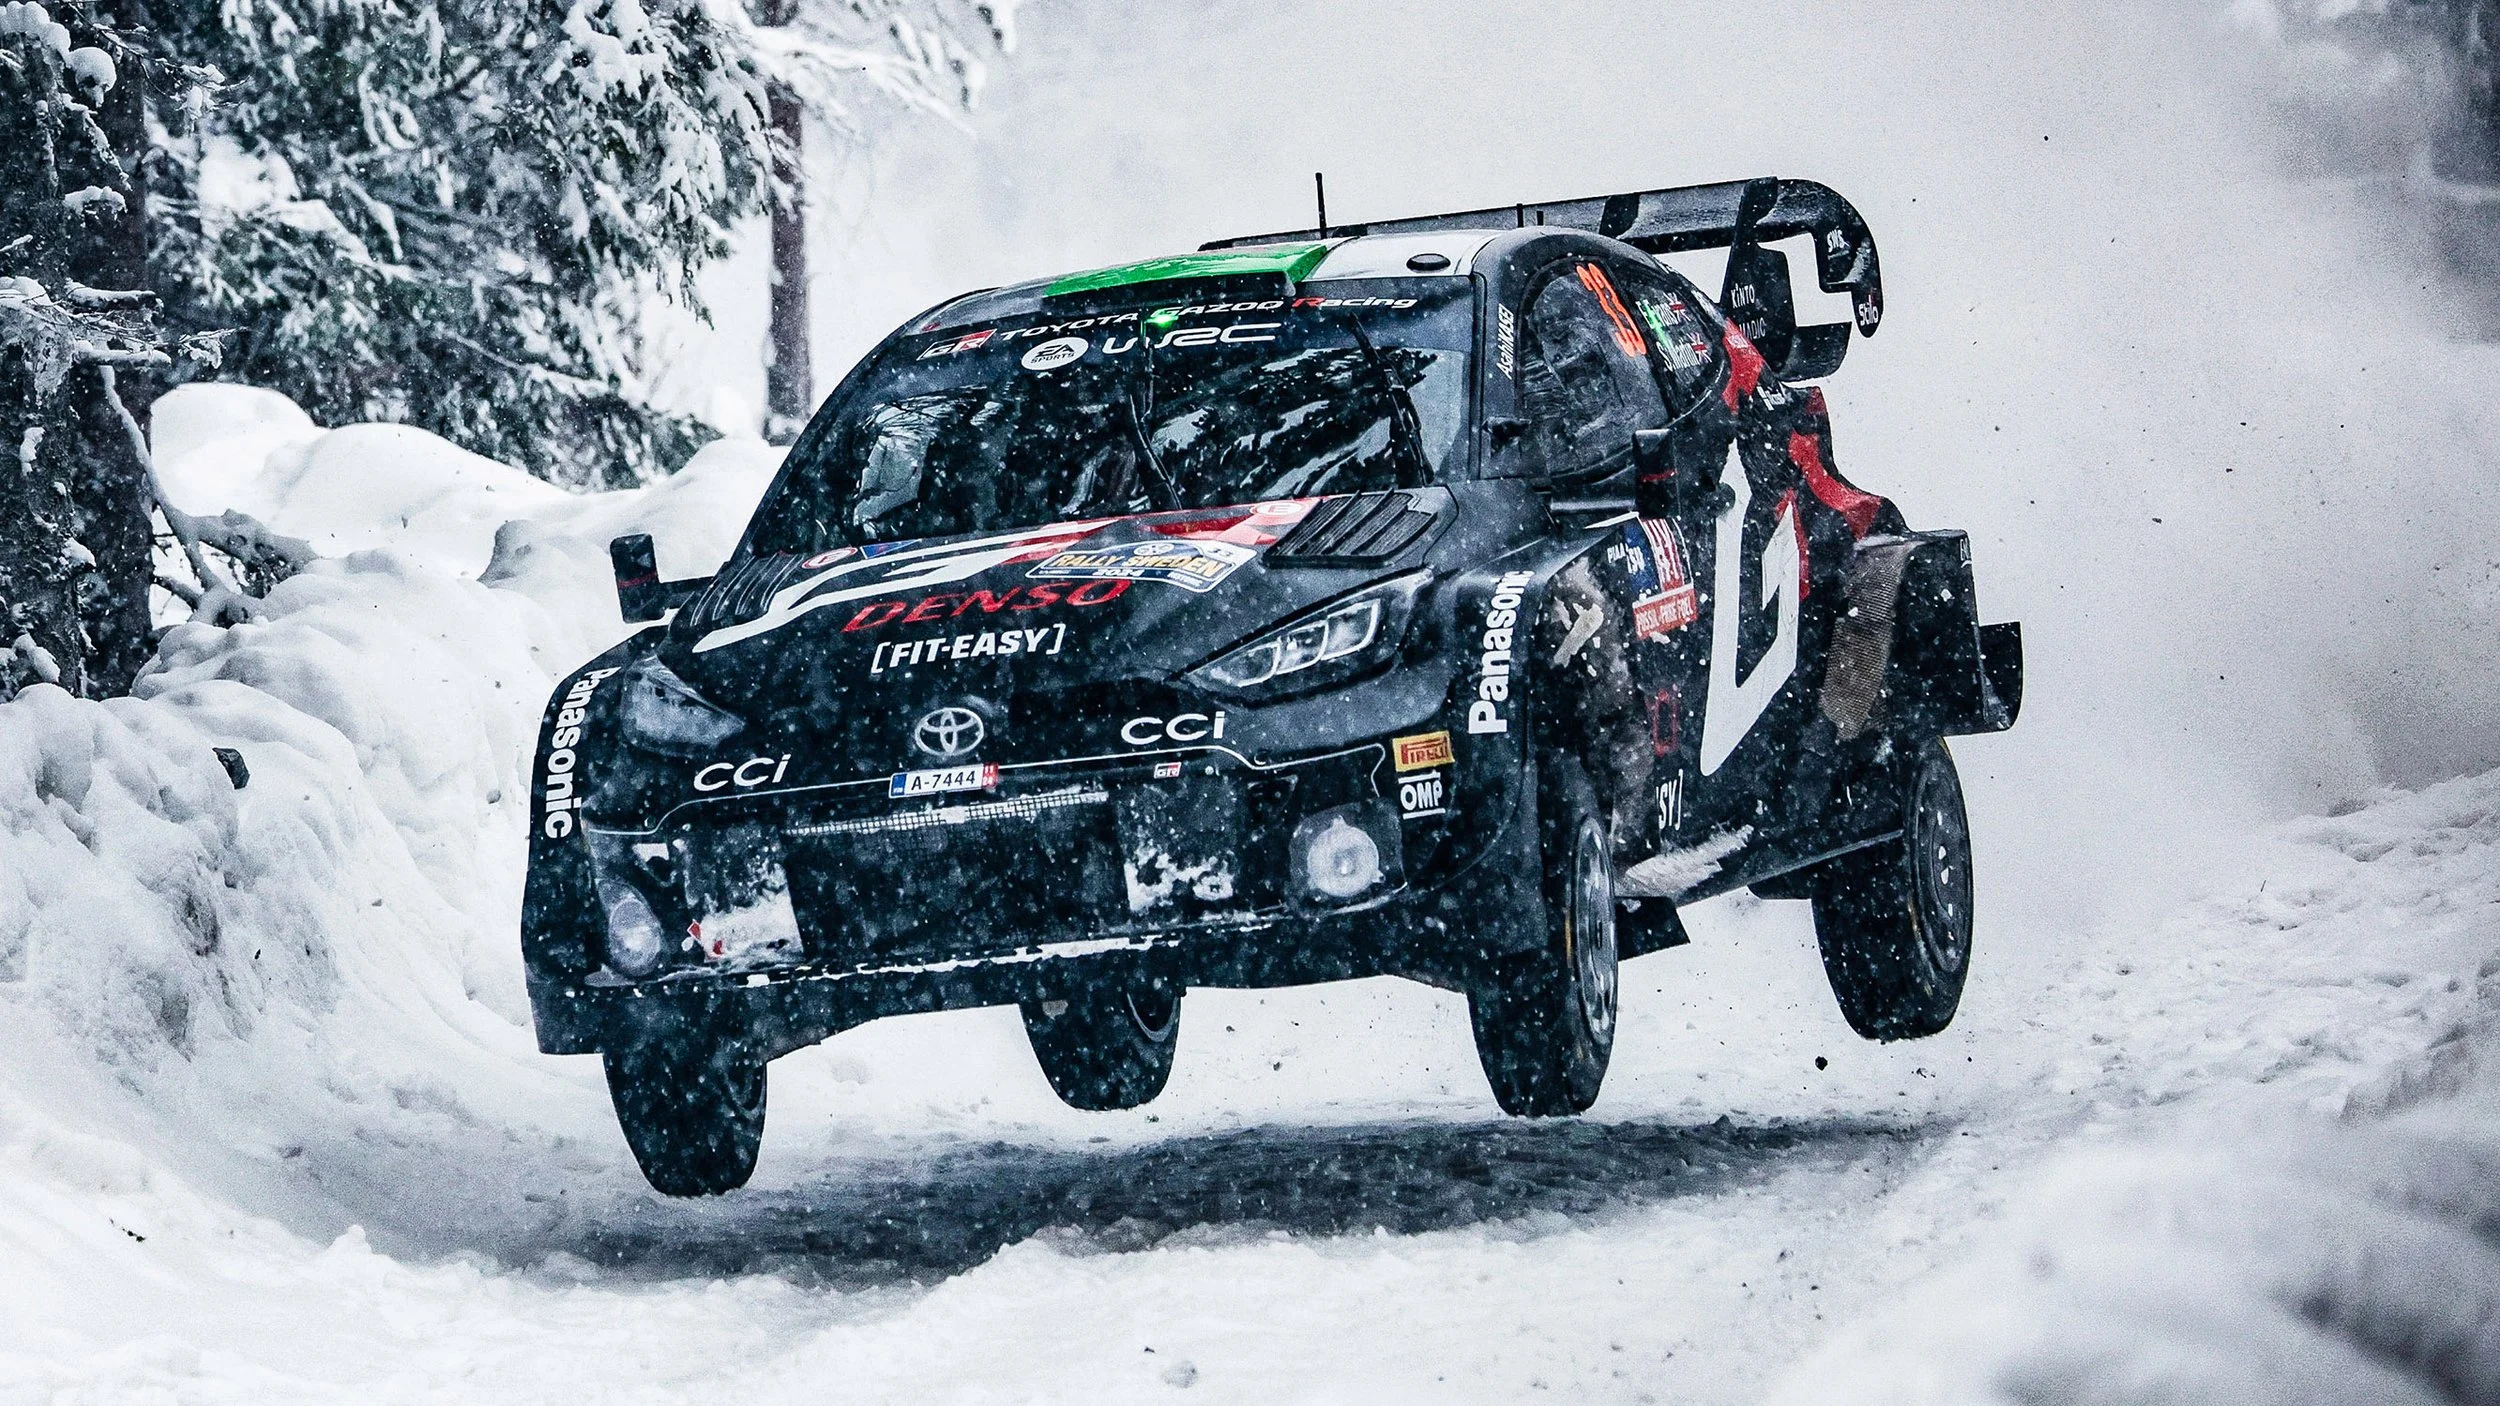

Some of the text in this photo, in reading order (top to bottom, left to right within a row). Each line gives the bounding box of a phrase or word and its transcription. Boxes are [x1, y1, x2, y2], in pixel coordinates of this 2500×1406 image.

[1000, 312, 1139, 341] TOYOTA
[1150, 300, 1285, 322] GAZOO
[1292, 296, 1419, 311] Racing
[1576, 263, 1646, 358] 33
[1051, 553, 1226, 578] RALLY SWEDEN
[840, 580, 1131, 632] DENSO
[1468, 569, 1534, 734] Panasonic
[545, 667, 620, 839] Panasonic
[911, 771, 975, 790] A-7444
[1400, 780, 1442, 810] OMP
